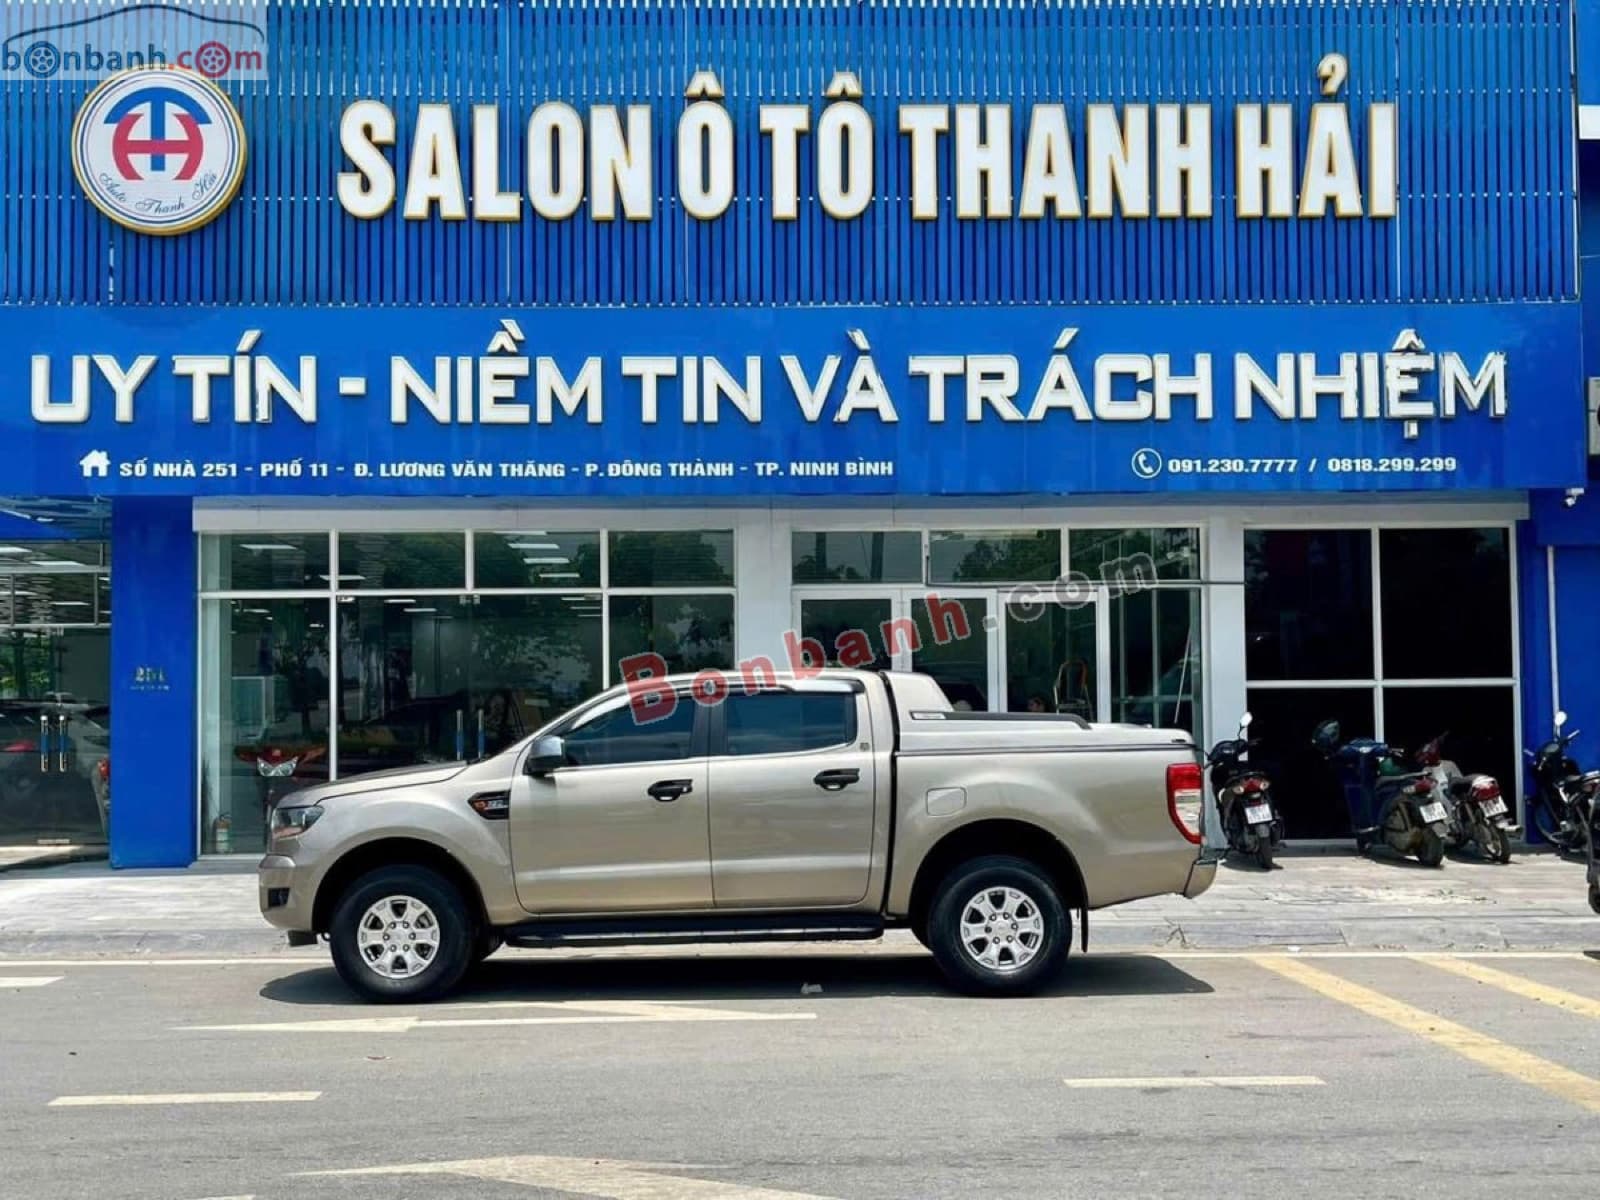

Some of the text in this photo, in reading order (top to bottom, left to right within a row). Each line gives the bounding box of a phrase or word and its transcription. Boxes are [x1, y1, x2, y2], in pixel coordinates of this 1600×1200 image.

[337, 53, 1397, 220] SALON Ô TÔ THANH HẢI
[135, 195, 186, 214] Thanh
[31, 355, 156, 422] UY
[172, 330, 316, 422] TÍN
[391, 319, 602, 423] NIỀM
[622, 356, 762, 423] TIN
[780, 328, 898, 422] VÀ
[909, 327, 1213, 421] TRÁCH
[1235, 328, 1507, 439] NHIỆM
[119, 458, 148, 477] SỐ
[153, 460, 196, 477] NHÀ
[202, 463, 238, 477] 251
[260, 459, 302, 477] PHỐ
[309, 463, 328, 477] 11
[354, 463, 373, 477] Đ.
[380, 462, 445, 477] LƯƠNG
[451, 461, 493, 477] VĂN
[499, 461, 565, 477] THĂNG
[585, 463, 604, 477] P.
[607, 459, 662, 477] ĐÔNG
[668, 459, 734, 476] THÀNH
[755, 463, 785, 476] TP.
[790, 462, 839, 476] NINH
[845, 457, 893, 476] BÌNH
[1168, 459, 1298, 474] 091.230.7777
[1327, 457, 1457, 473] 0818.299.299
